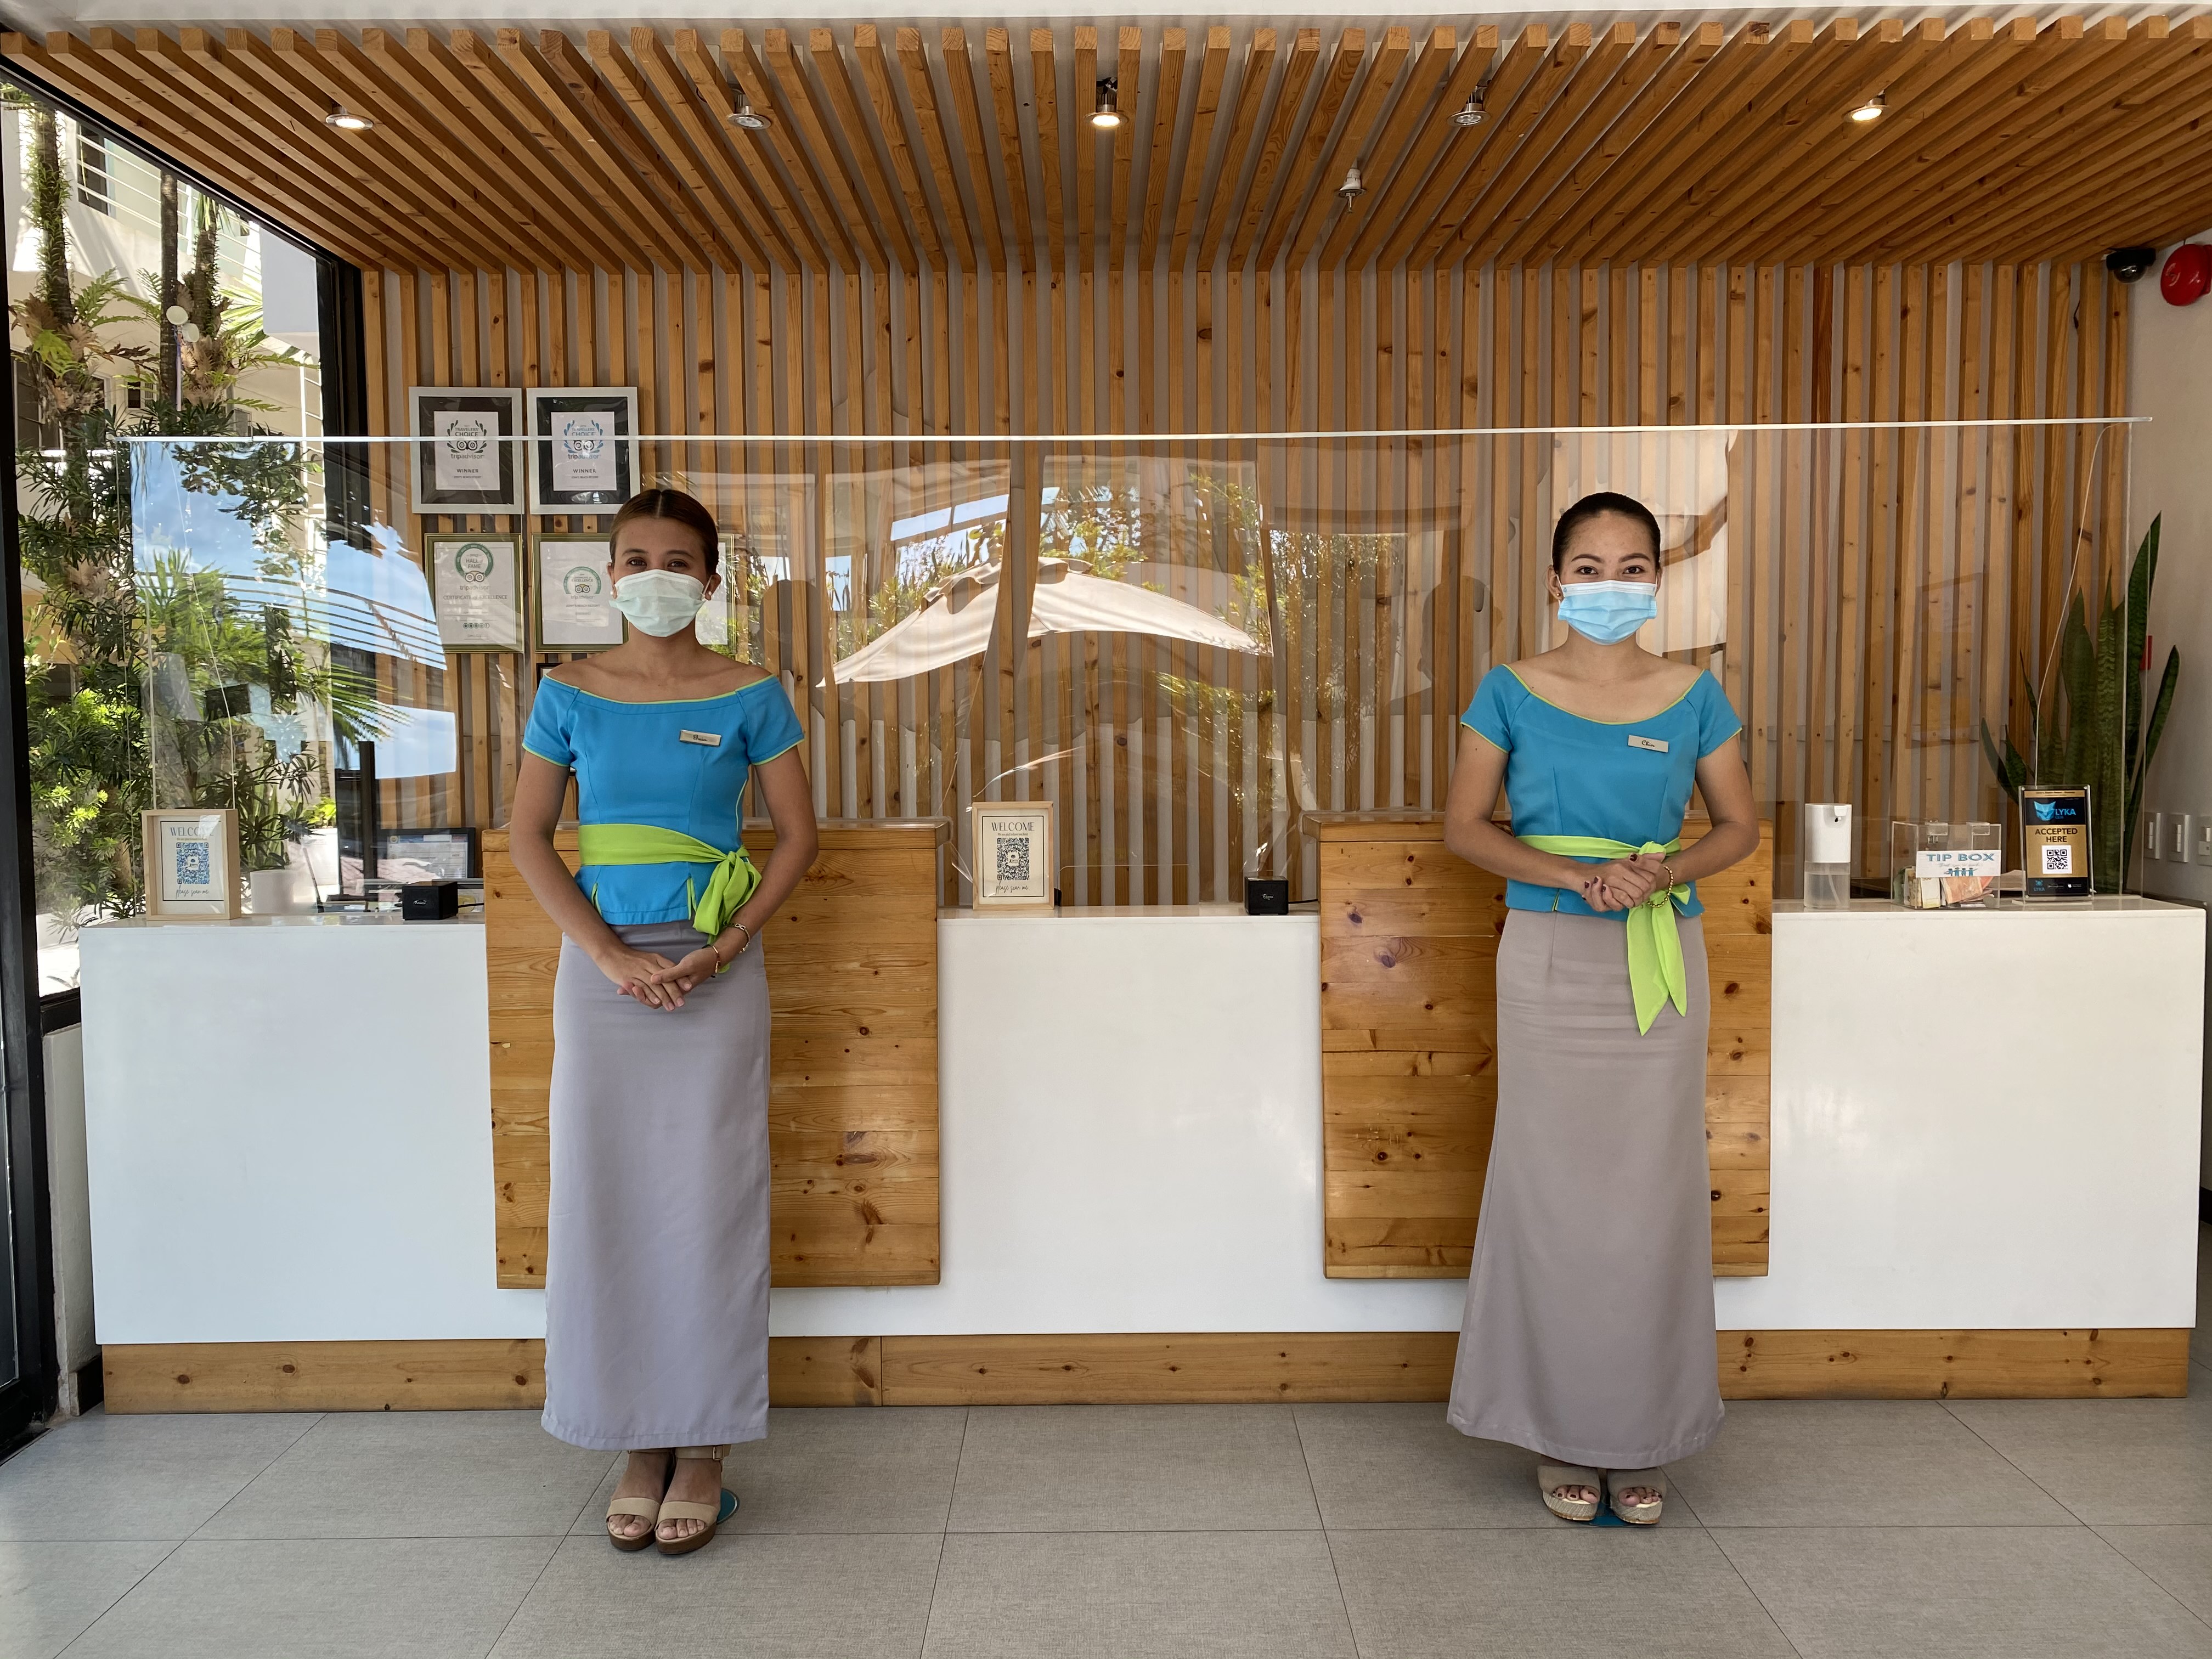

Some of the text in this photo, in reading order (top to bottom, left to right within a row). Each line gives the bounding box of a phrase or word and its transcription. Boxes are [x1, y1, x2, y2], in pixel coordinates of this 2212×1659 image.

[2055, 808, 2076, 816] LYKA
[991, 822, 1035, 832] WELCOME
[170, 827, 214, 837] WELCO
[1927, 853, 1995, 862] TIP BOX
